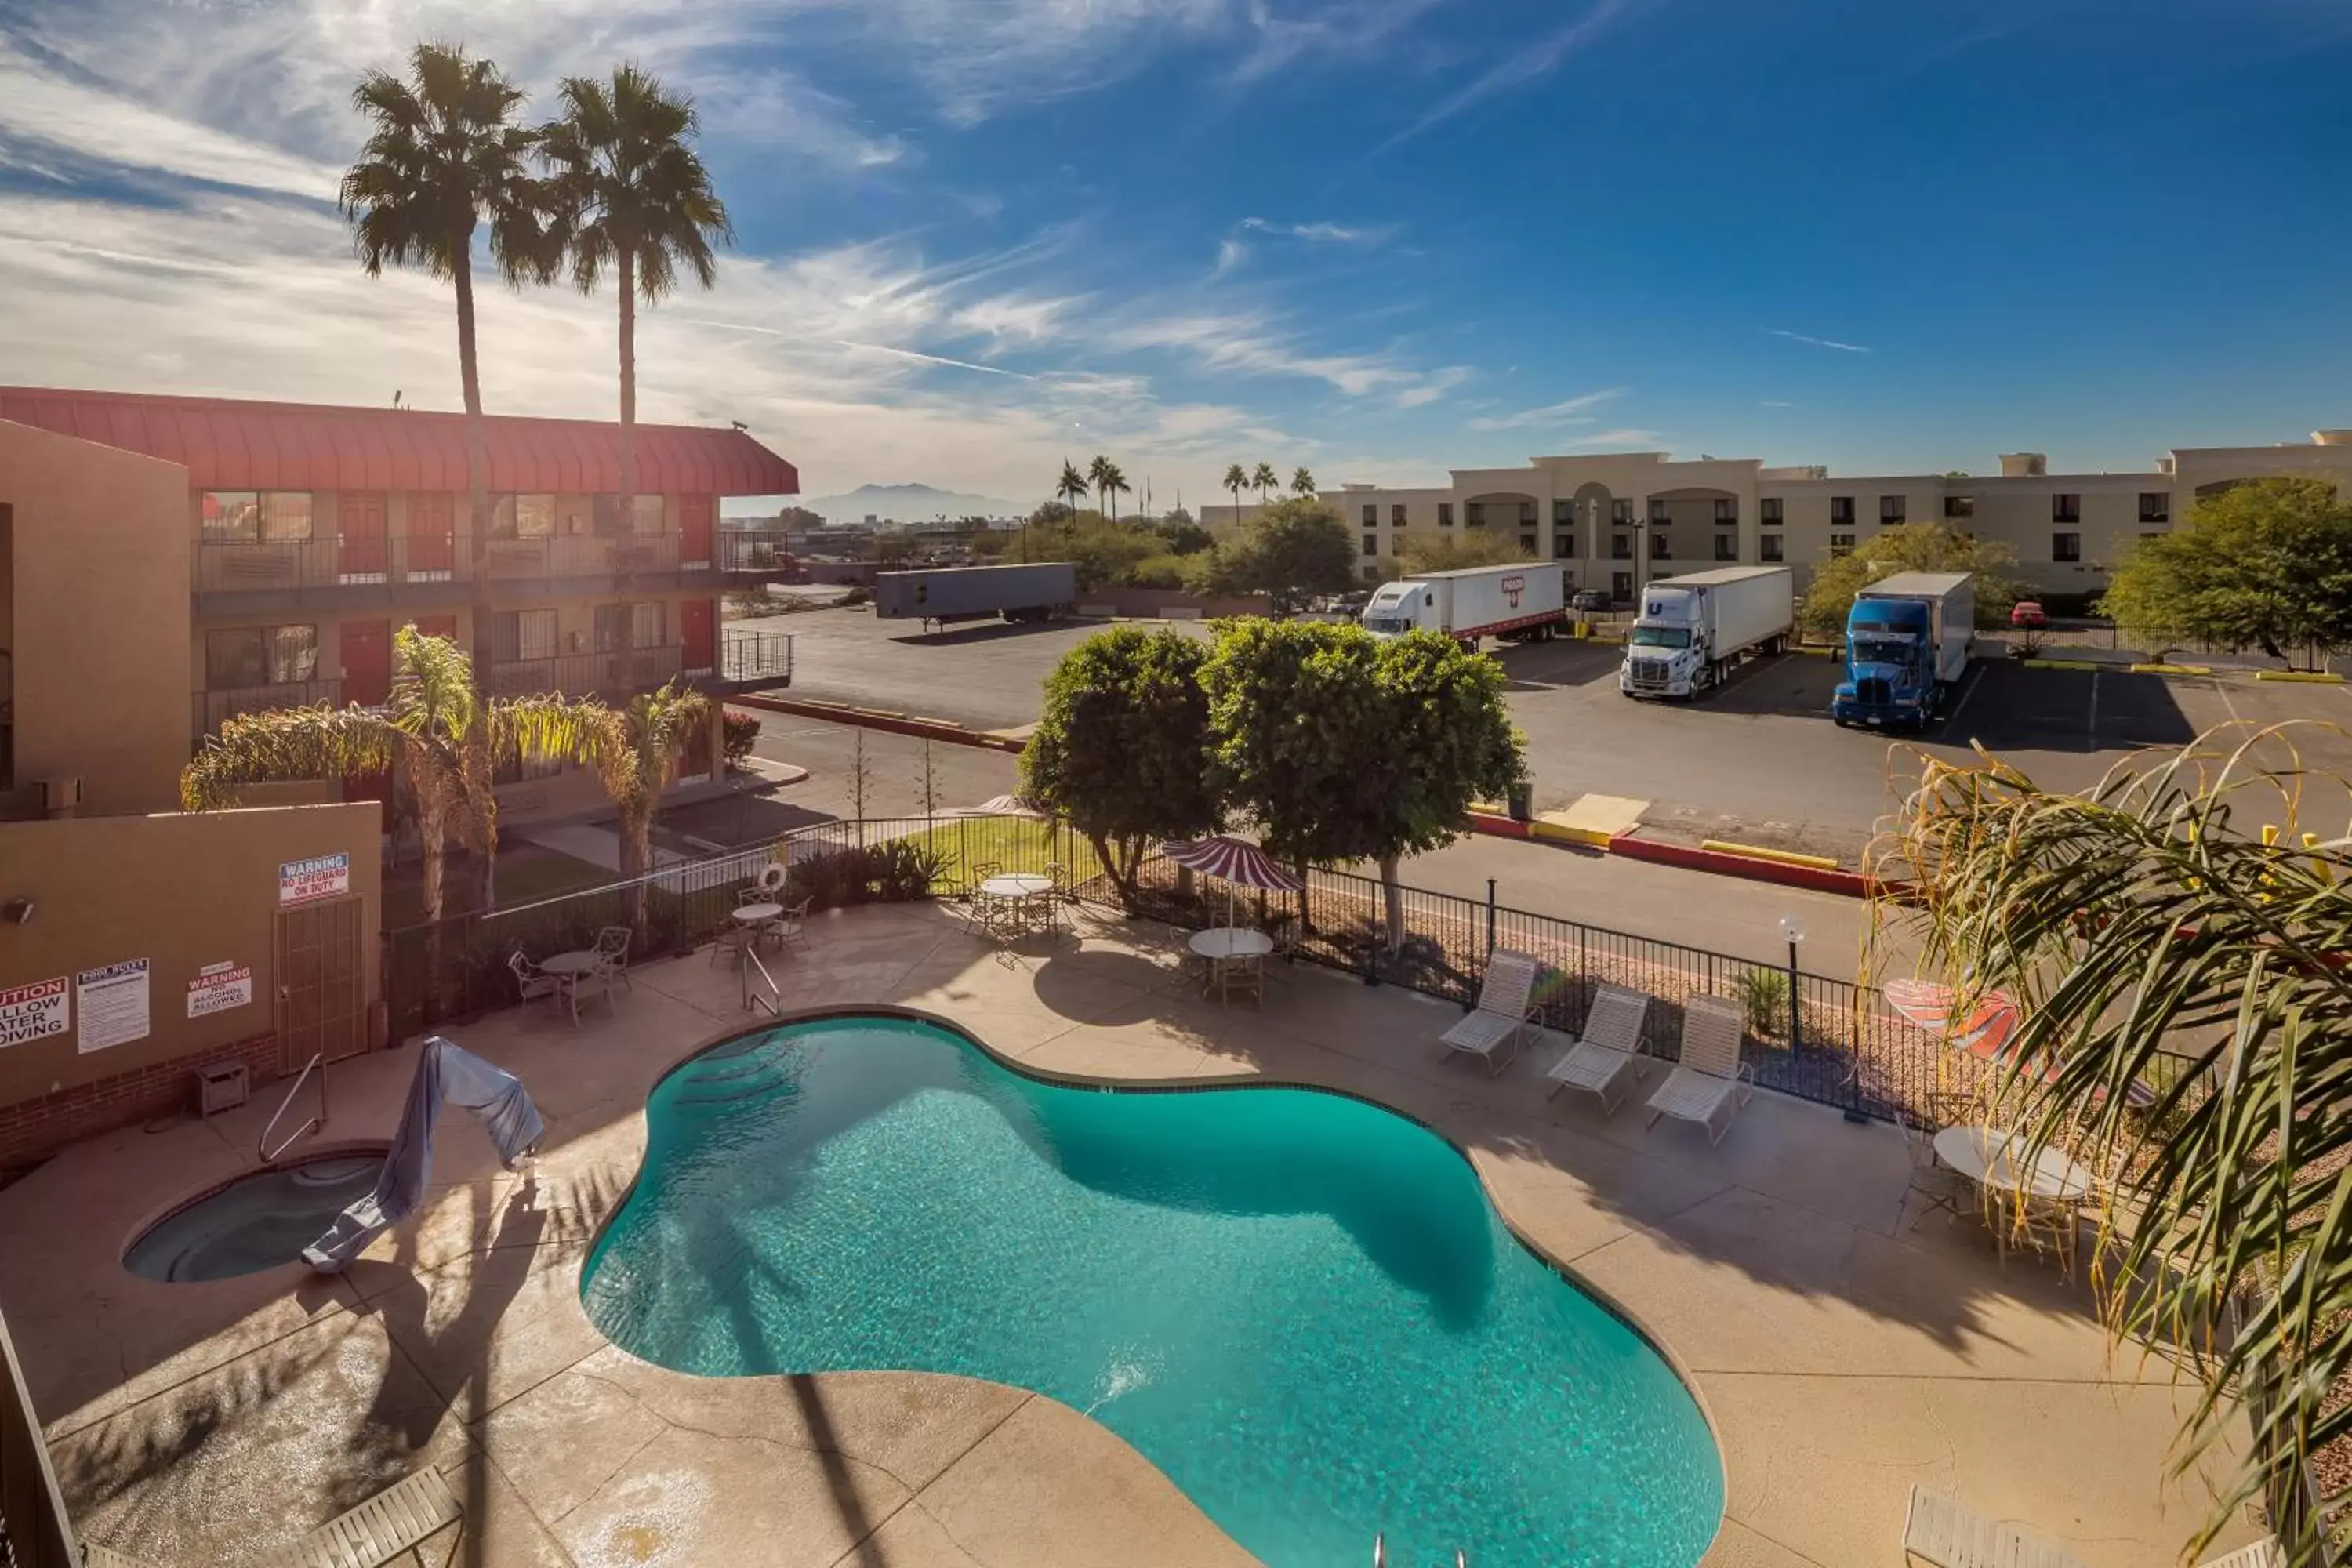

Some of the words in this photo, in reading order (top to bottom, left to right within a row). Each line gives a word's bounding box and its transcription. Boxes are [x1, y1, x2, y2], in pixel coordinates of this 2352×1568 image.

[285, 855, 343, 876] WARNING
[282, 877, 295, 887] NO
[299, 868, 346, 885] LIFEGUARD
[295, 886, 307, 895] ON
[311, 880, 334, 893] DUTY
[189, 967, 250, 989] WARNING
[194, 988, 241, 1003] ALCOHOL
[212, 984, 225, 993] NO
[194, 993, 245, 1011] ALLOWED
